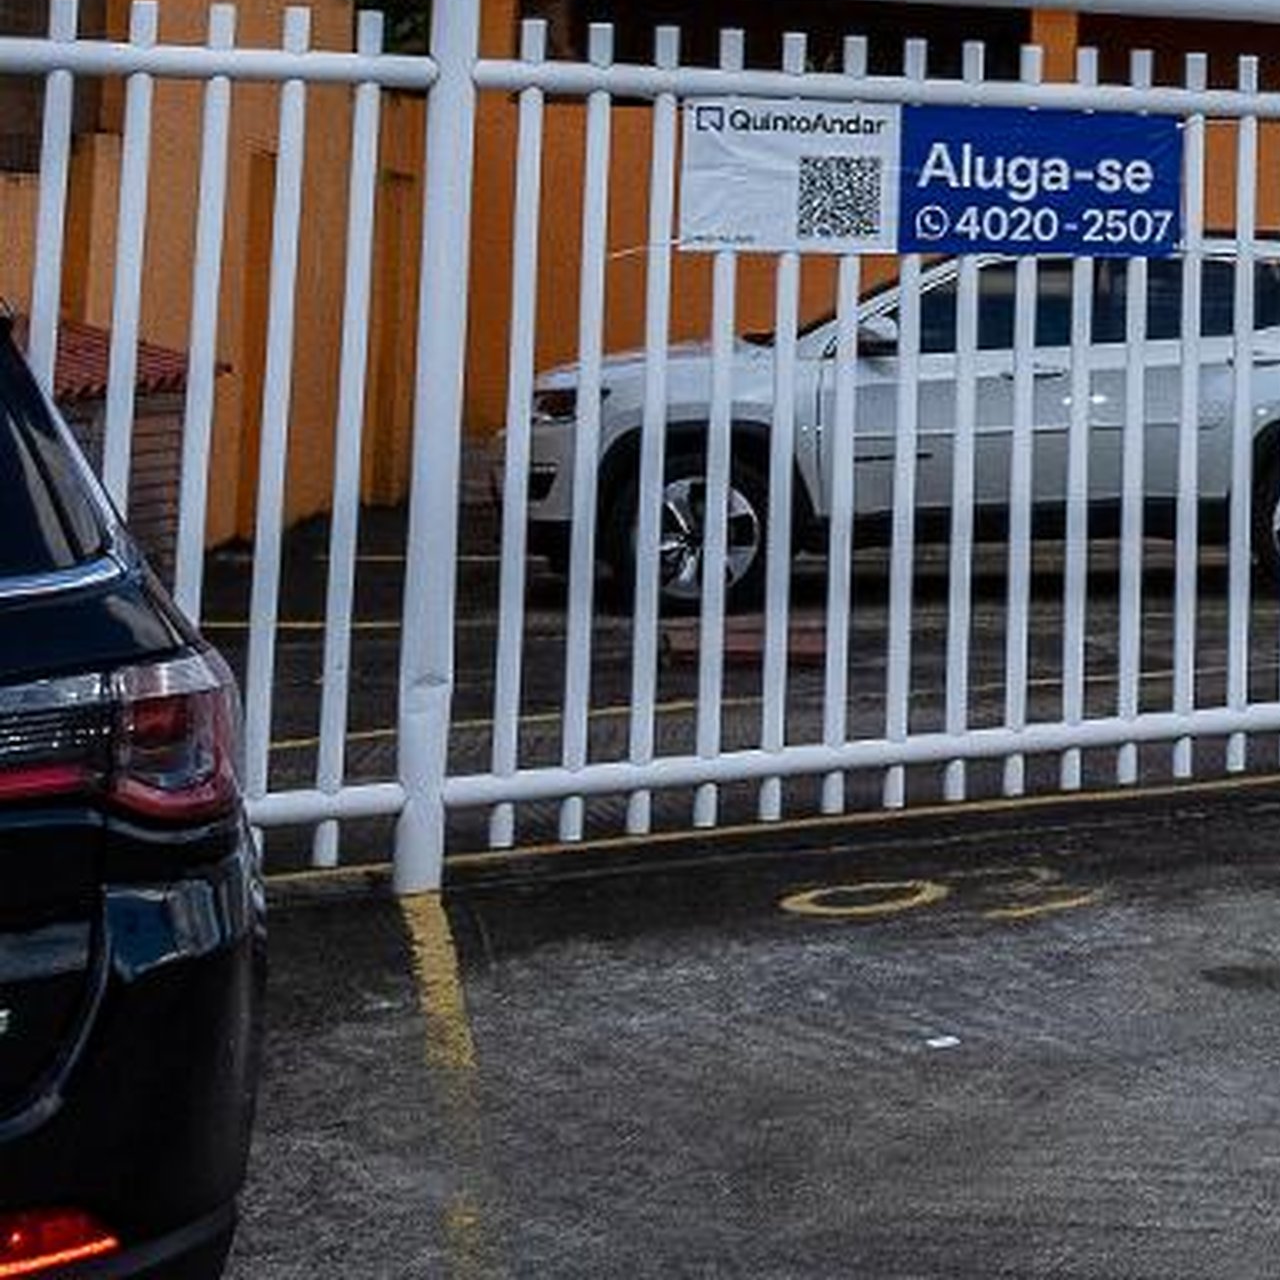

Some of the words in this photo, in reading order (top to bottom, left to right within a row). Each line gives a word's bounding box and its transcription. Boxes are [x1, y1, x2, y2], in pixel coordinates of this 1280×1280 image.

[729, 108, 886, 135] QuintoAndar
[917, 142, 1154, 202] Aluga-se
[954, 205, 1174, 243] 4020-2507
